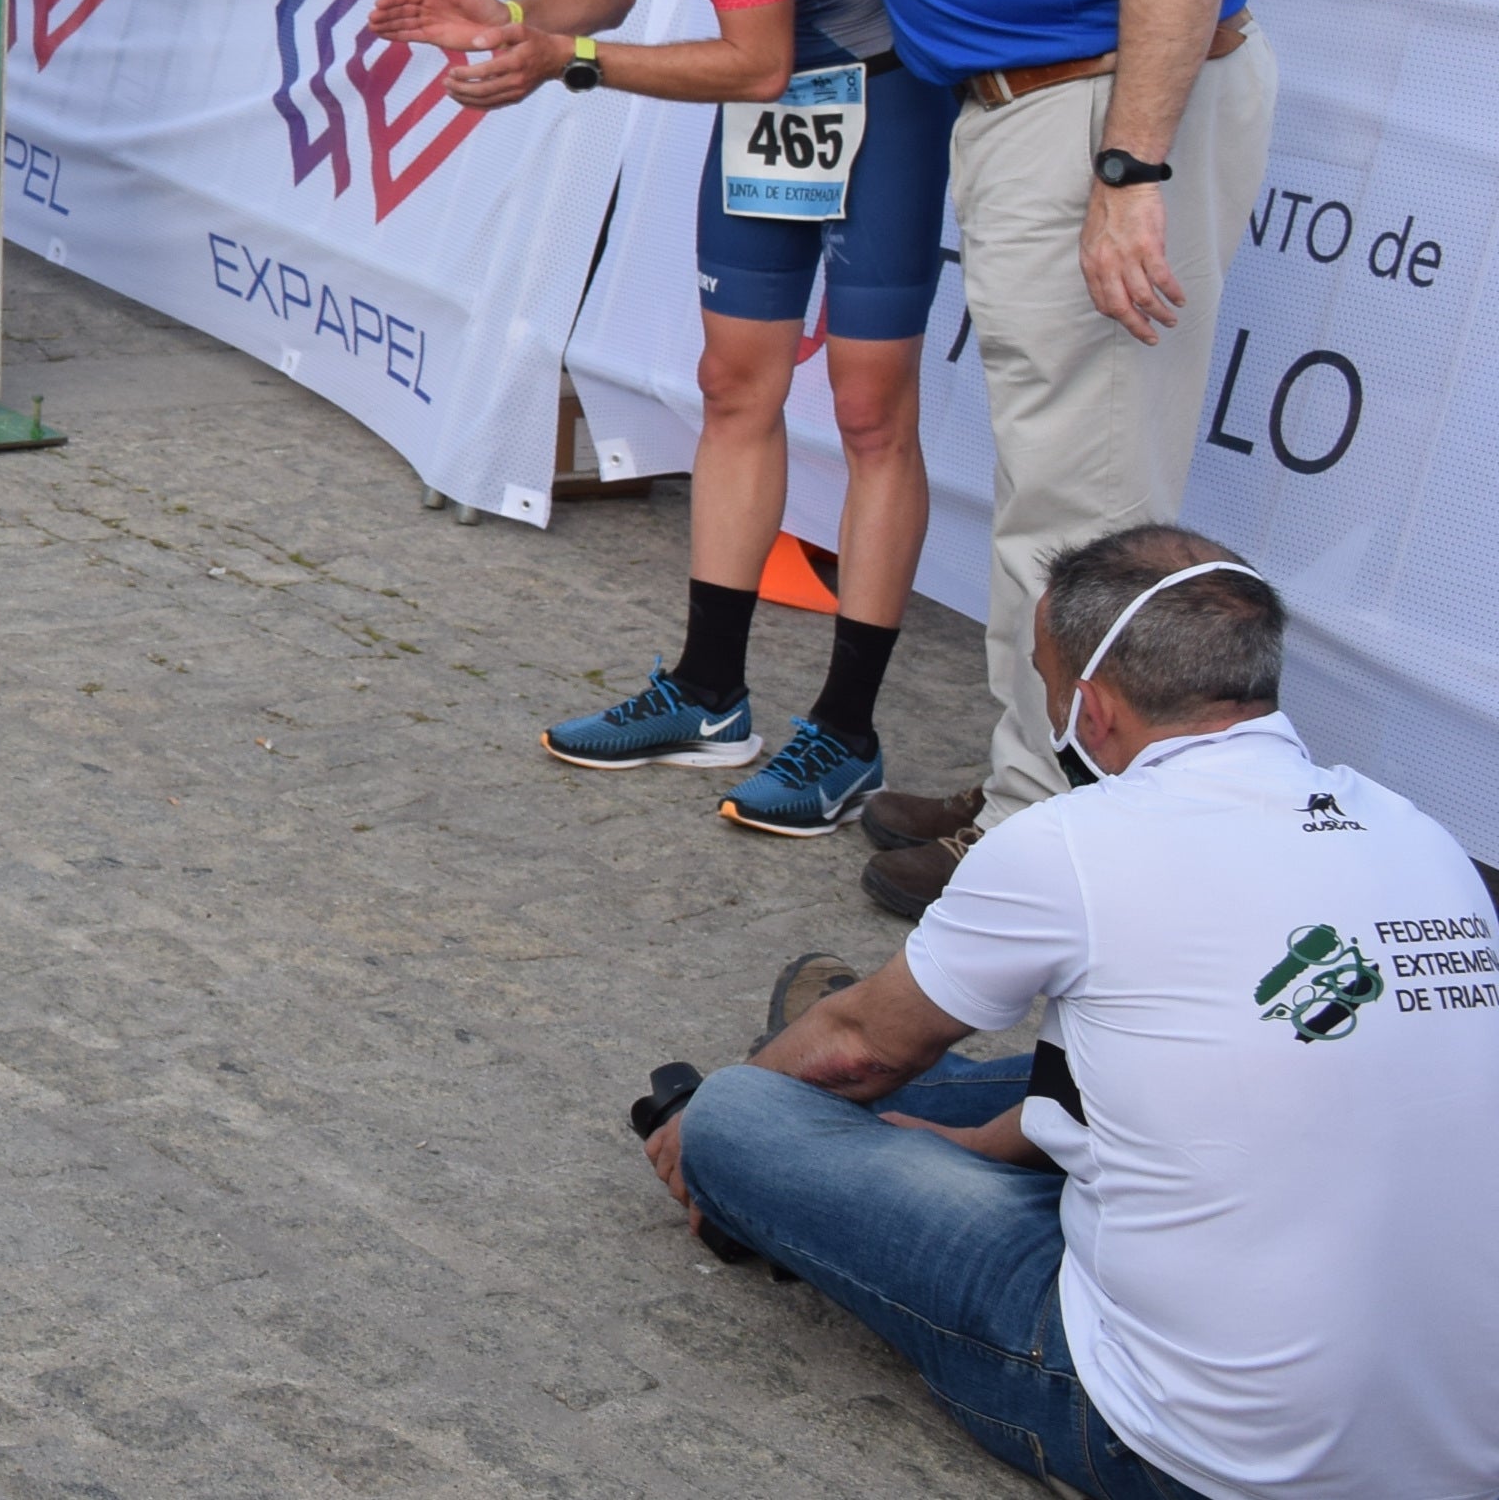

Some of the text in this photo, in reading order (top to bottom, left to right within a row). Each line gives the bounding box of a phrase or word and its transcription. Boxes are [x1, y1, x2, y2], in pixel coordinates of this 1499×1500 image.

[747, 111, 844, 170] 465
[728, 183, 759, 199] JUNTA
[766, 185, 779, 199] DE
[1369, 214, 1443, 288] de
[208, 232, 433, 405] EXPAPEL
[1303, 819, 1368, 833] austral
[1374, 911, 1492, 944] FEDERACIÓN
[1395, 988, 1432, 1013] DE
